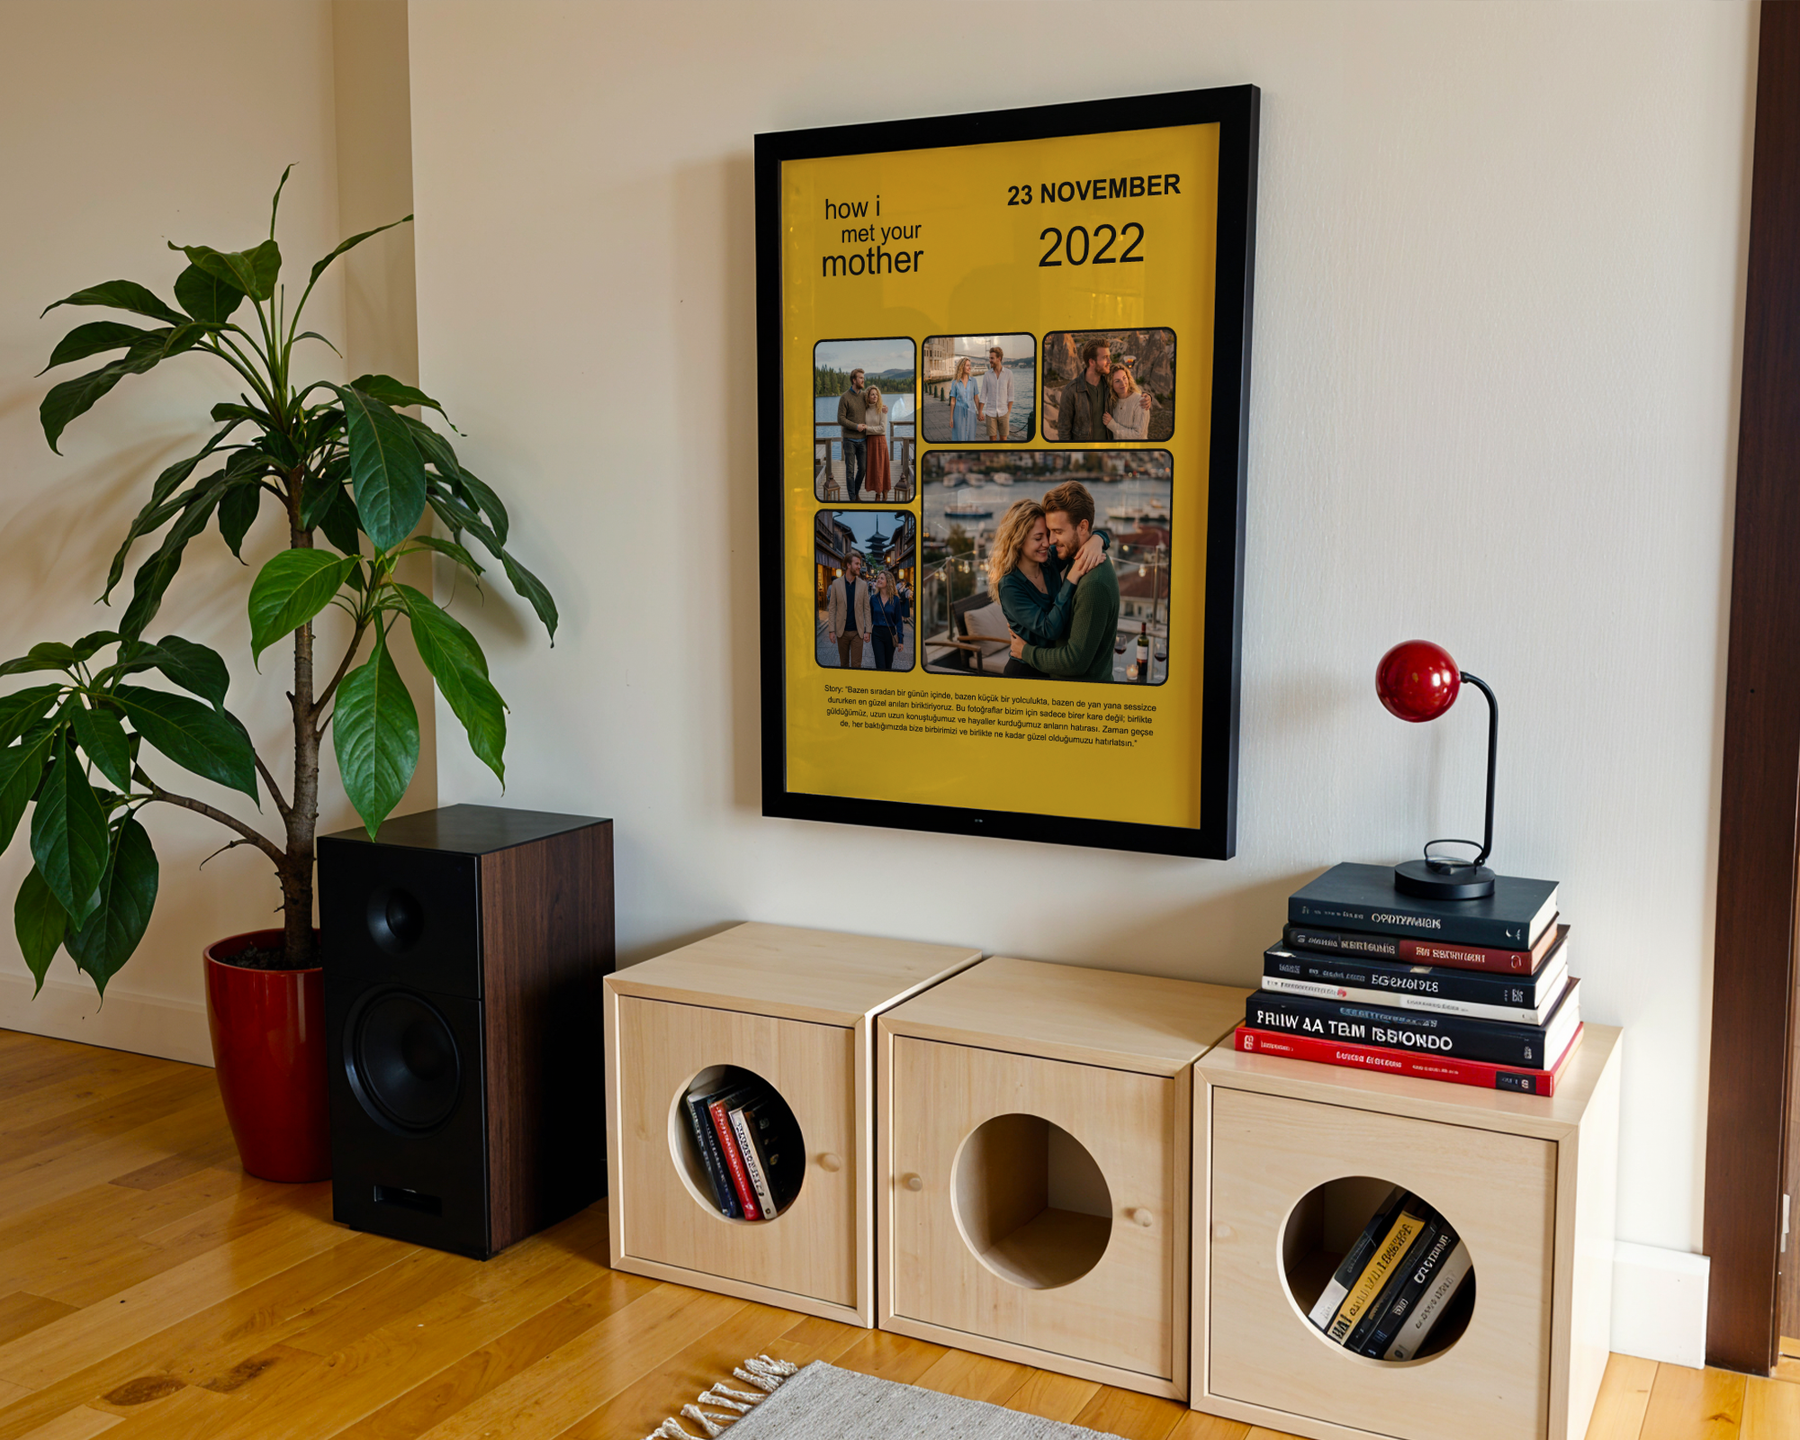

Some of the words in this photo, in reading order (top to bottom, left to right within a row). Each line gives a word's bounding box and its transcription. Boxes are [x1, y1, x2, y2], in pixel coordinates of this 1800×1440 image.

[1007, 184, 1033, 206] 23
[1040, 174, 1181, 204] NOVEMBER
[825, 198, 869, 220] how
[876, 195, 881, 217] i
[841, 224, 876, 244] met
[880, 224, 922, 246] your
[1038, 222, 1145, 268] 2022
[822, 246, 924, 277] mother
[824, 684, 844, 695] Story:
[869, 688, 896, 696] sıradan
[896, 688, 906, 697] bir
[907, 689, 929, 699] günün
[930, 690, 953, 701] içinde,
[954, 692, 977, 701] bazen
[977, 693, 999, 704] küçük
[1000, 695, 1011, 703] bir
[1011, 696, 1050, 706] yolculukta,
[1051, 698, 1075, 707] bazen
[1075, 699, 1086, 708] de
[1087, 701, 1102, 710] yan
[1103, 702, 1122, 711] yana
[1123, 703, 1157, 712] sessizce
[827, 696, 857, 705] dururken
[868, 698, 887, 708] güzel
[955, 703, 966, 712] Bu
[1004, 707, 1024, 716] bizim
[1025, 708, 1038, 718] için
[1039, 709, 1067, 719] sadece
[1067, 711, 1086, 720] birer
[1086, 712, 1104, 721] kare
[1127, 714, 1153, 724] birlikte
[839, 719, 851, 728] de,
[851, 720, 864, 728] her
[908, 724, 924, 733] bize
[924, 725, 958, 735] birbirimizi
[969, 728, 993, 738] birlikte
[1004, 730, 1026, 740] kadar
[1026, 732, 1047, 742] güzel
[906, 712, 956, 724] konuştuğumuz
[967, 716, 996, 727] hayaller
[997, 718, 1042, 730] kurduğumuz
[1070, 723, 1101, 733] hatırası.
[1101, 724, 1129, 735] Zaman
[1130, 728, 1154, 738] geçse
